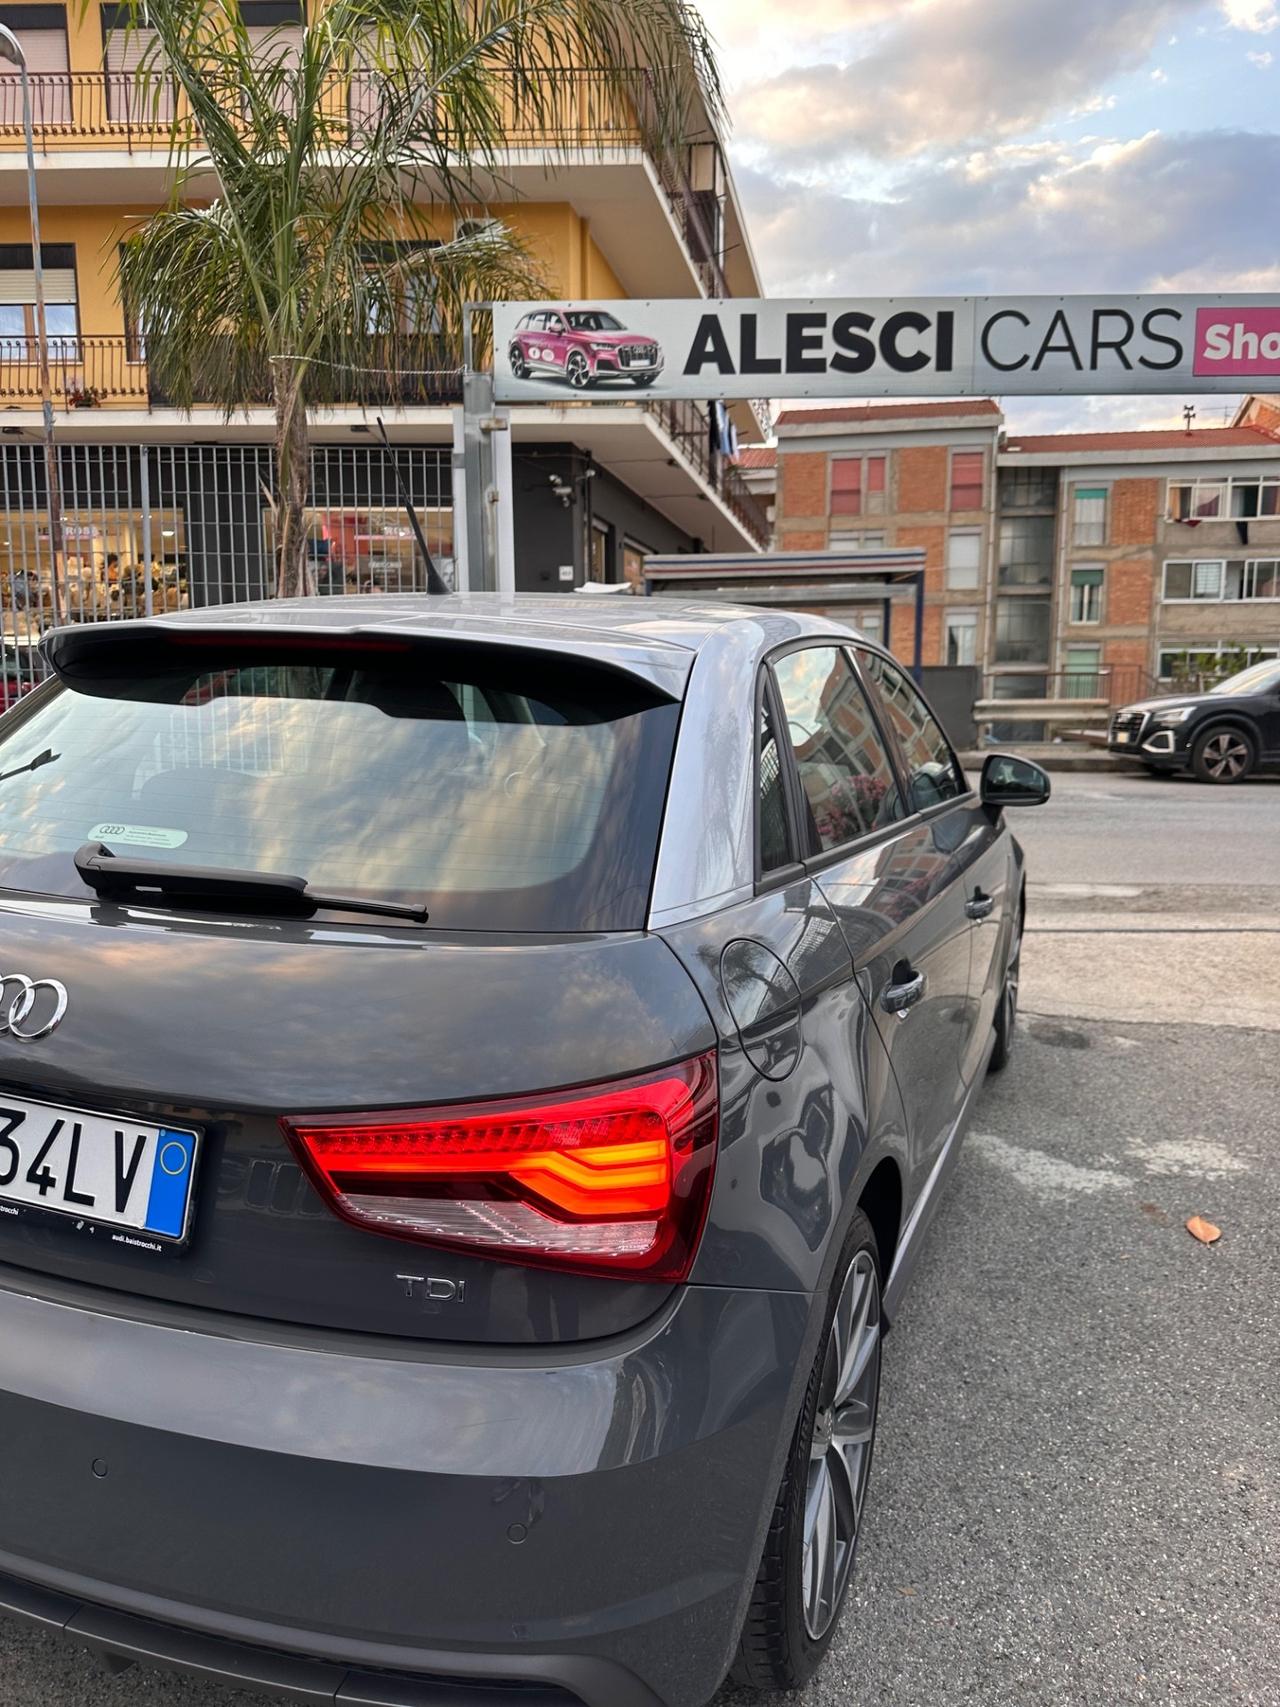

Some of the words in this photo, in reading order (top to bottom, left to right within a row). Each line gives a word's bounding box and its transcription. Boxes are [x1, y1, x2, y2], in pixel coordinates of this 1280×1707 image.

[683, 311, 954, 375] ALESCI
[980, 308, 1183, 371] CARS
[1203, 323, 1280, 360] Sho
[396, 1274, 465, 1302] TDI
